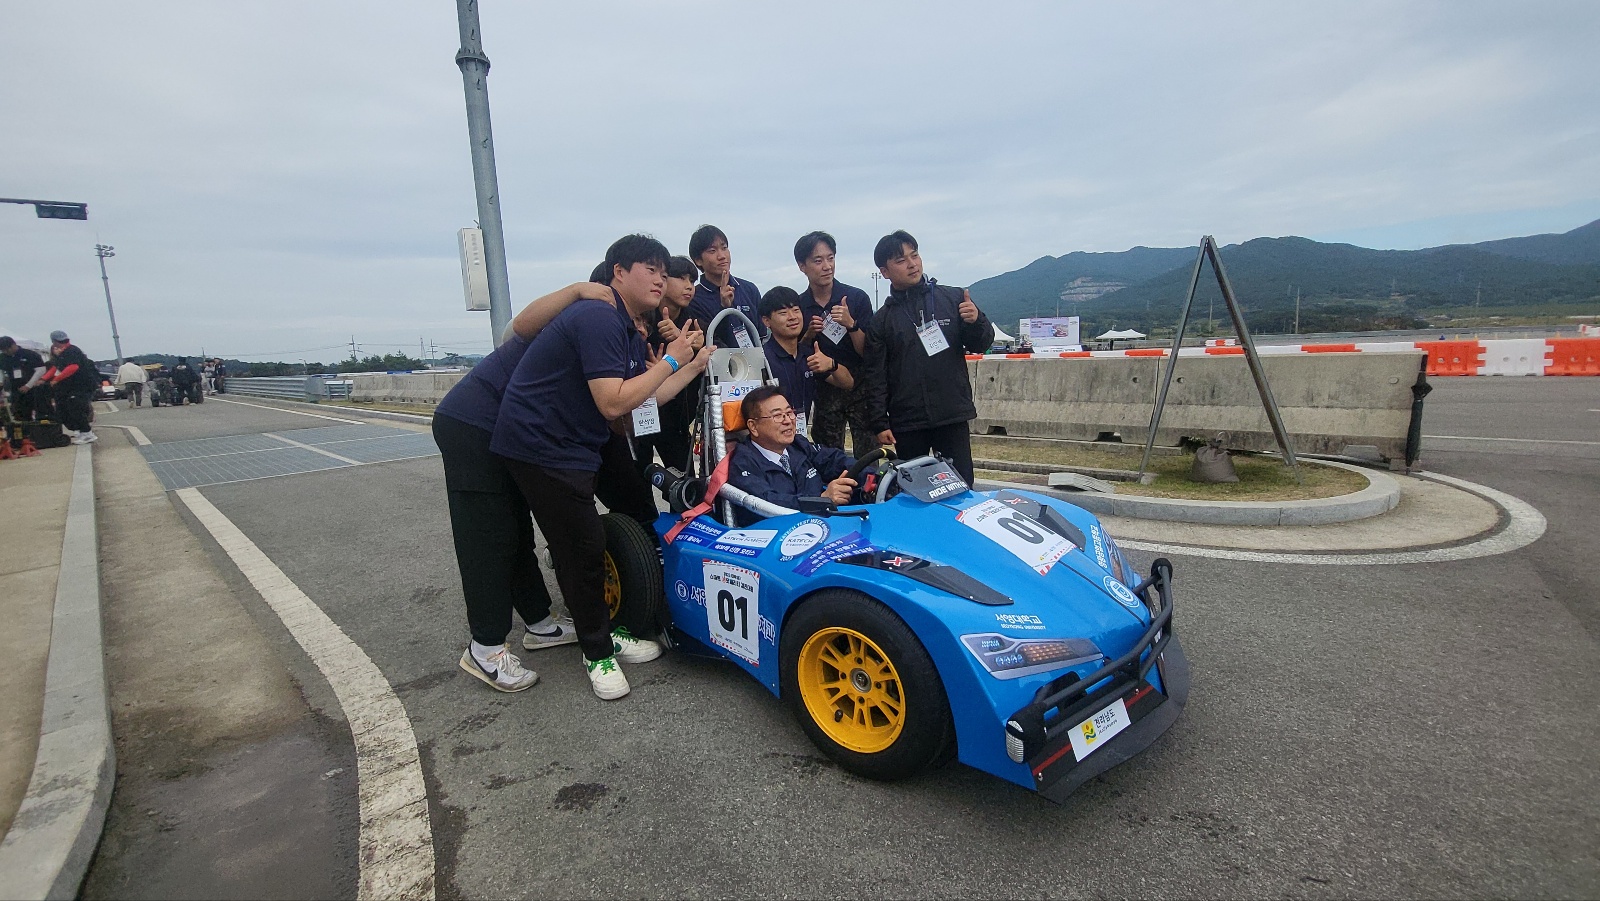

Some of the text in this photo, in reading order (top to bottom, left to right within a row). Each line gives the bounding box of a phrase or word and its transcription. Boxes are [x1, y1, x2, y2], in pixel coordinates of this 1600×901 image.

[928, 486, 948, 499] RIDE
[946, 481, 962, 492] WITH
[997, 511, 1056, 545] 01
[717, 589, 749, 640] 01
[1093, 708, 1116, 729] 전라남도
